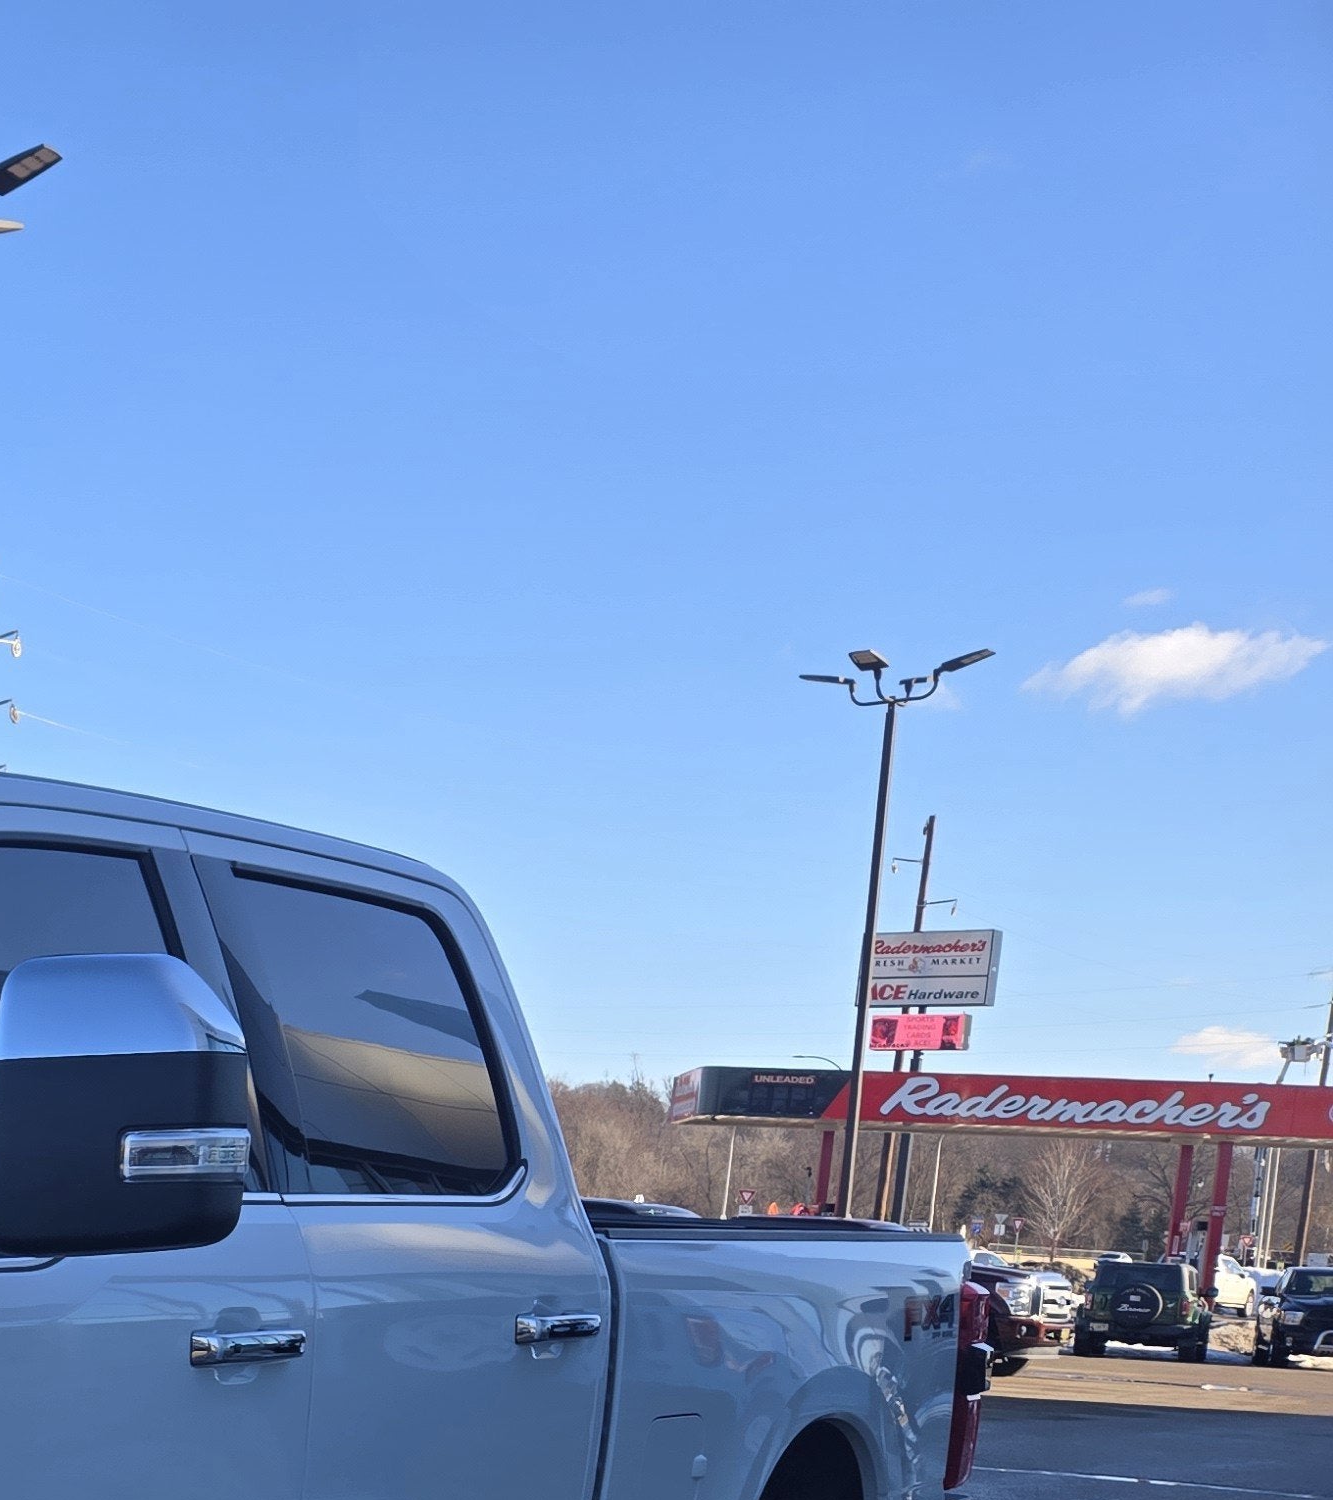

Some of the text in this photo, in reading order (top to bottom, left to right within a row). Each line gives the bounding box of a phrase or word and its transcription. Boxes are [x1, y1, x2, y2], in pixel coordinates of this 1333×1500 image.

[874, 957, 982, 967] RESH MARKET
[907, 988, 980, 1000] Hardware
[754, 1075, 815, 1084] UNLEADED
[879, 1075, 1272, 1130] Radermacher's
[904, 1294, 955, 1341] FX4
